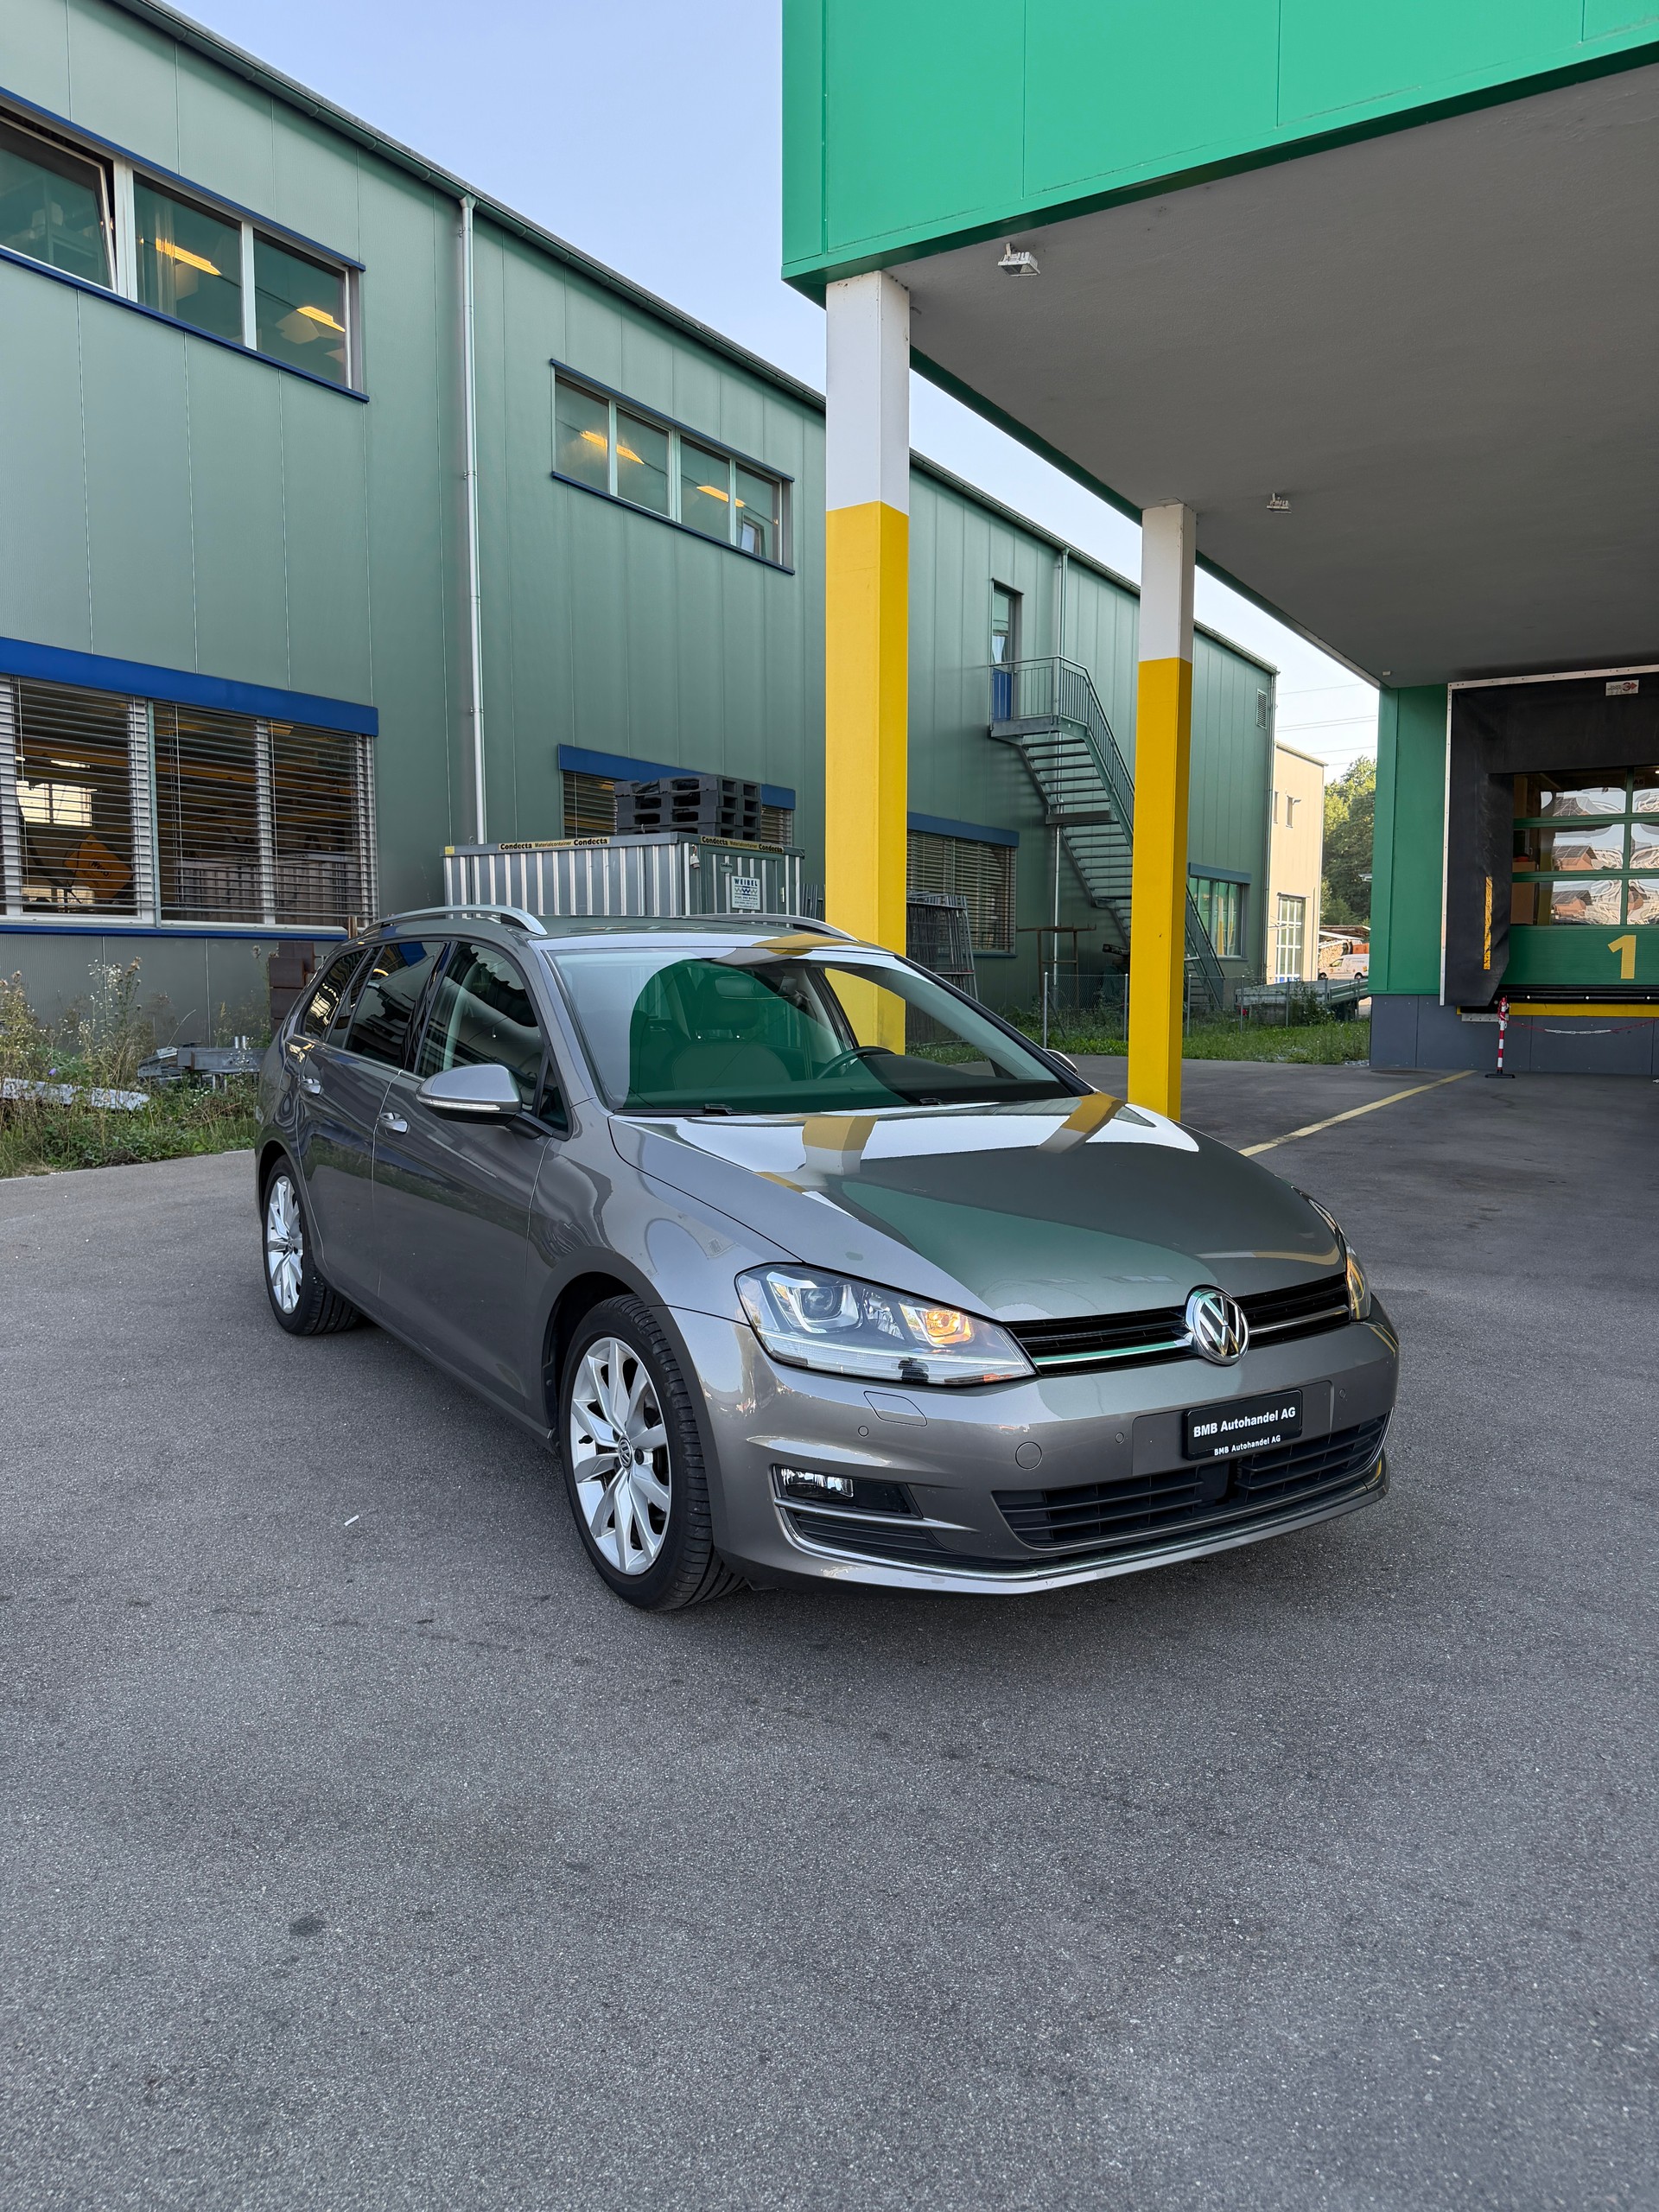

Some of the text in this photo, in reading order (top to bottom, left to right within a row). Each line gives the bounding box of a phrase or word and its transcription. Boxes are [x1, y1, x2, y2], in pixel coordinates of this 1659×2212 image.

[702, 836, 728, 845] Condecta
[759, 844, 783, 853] Condecta
[734, 878, 758, 887] WEIBEL
[1607, 934, 1637, 980] 1
[1193, 1407, 1296, 1438] BMB Autohandel AG
[1214, 1434, 1281, 1456] BMB Autohandel AG
